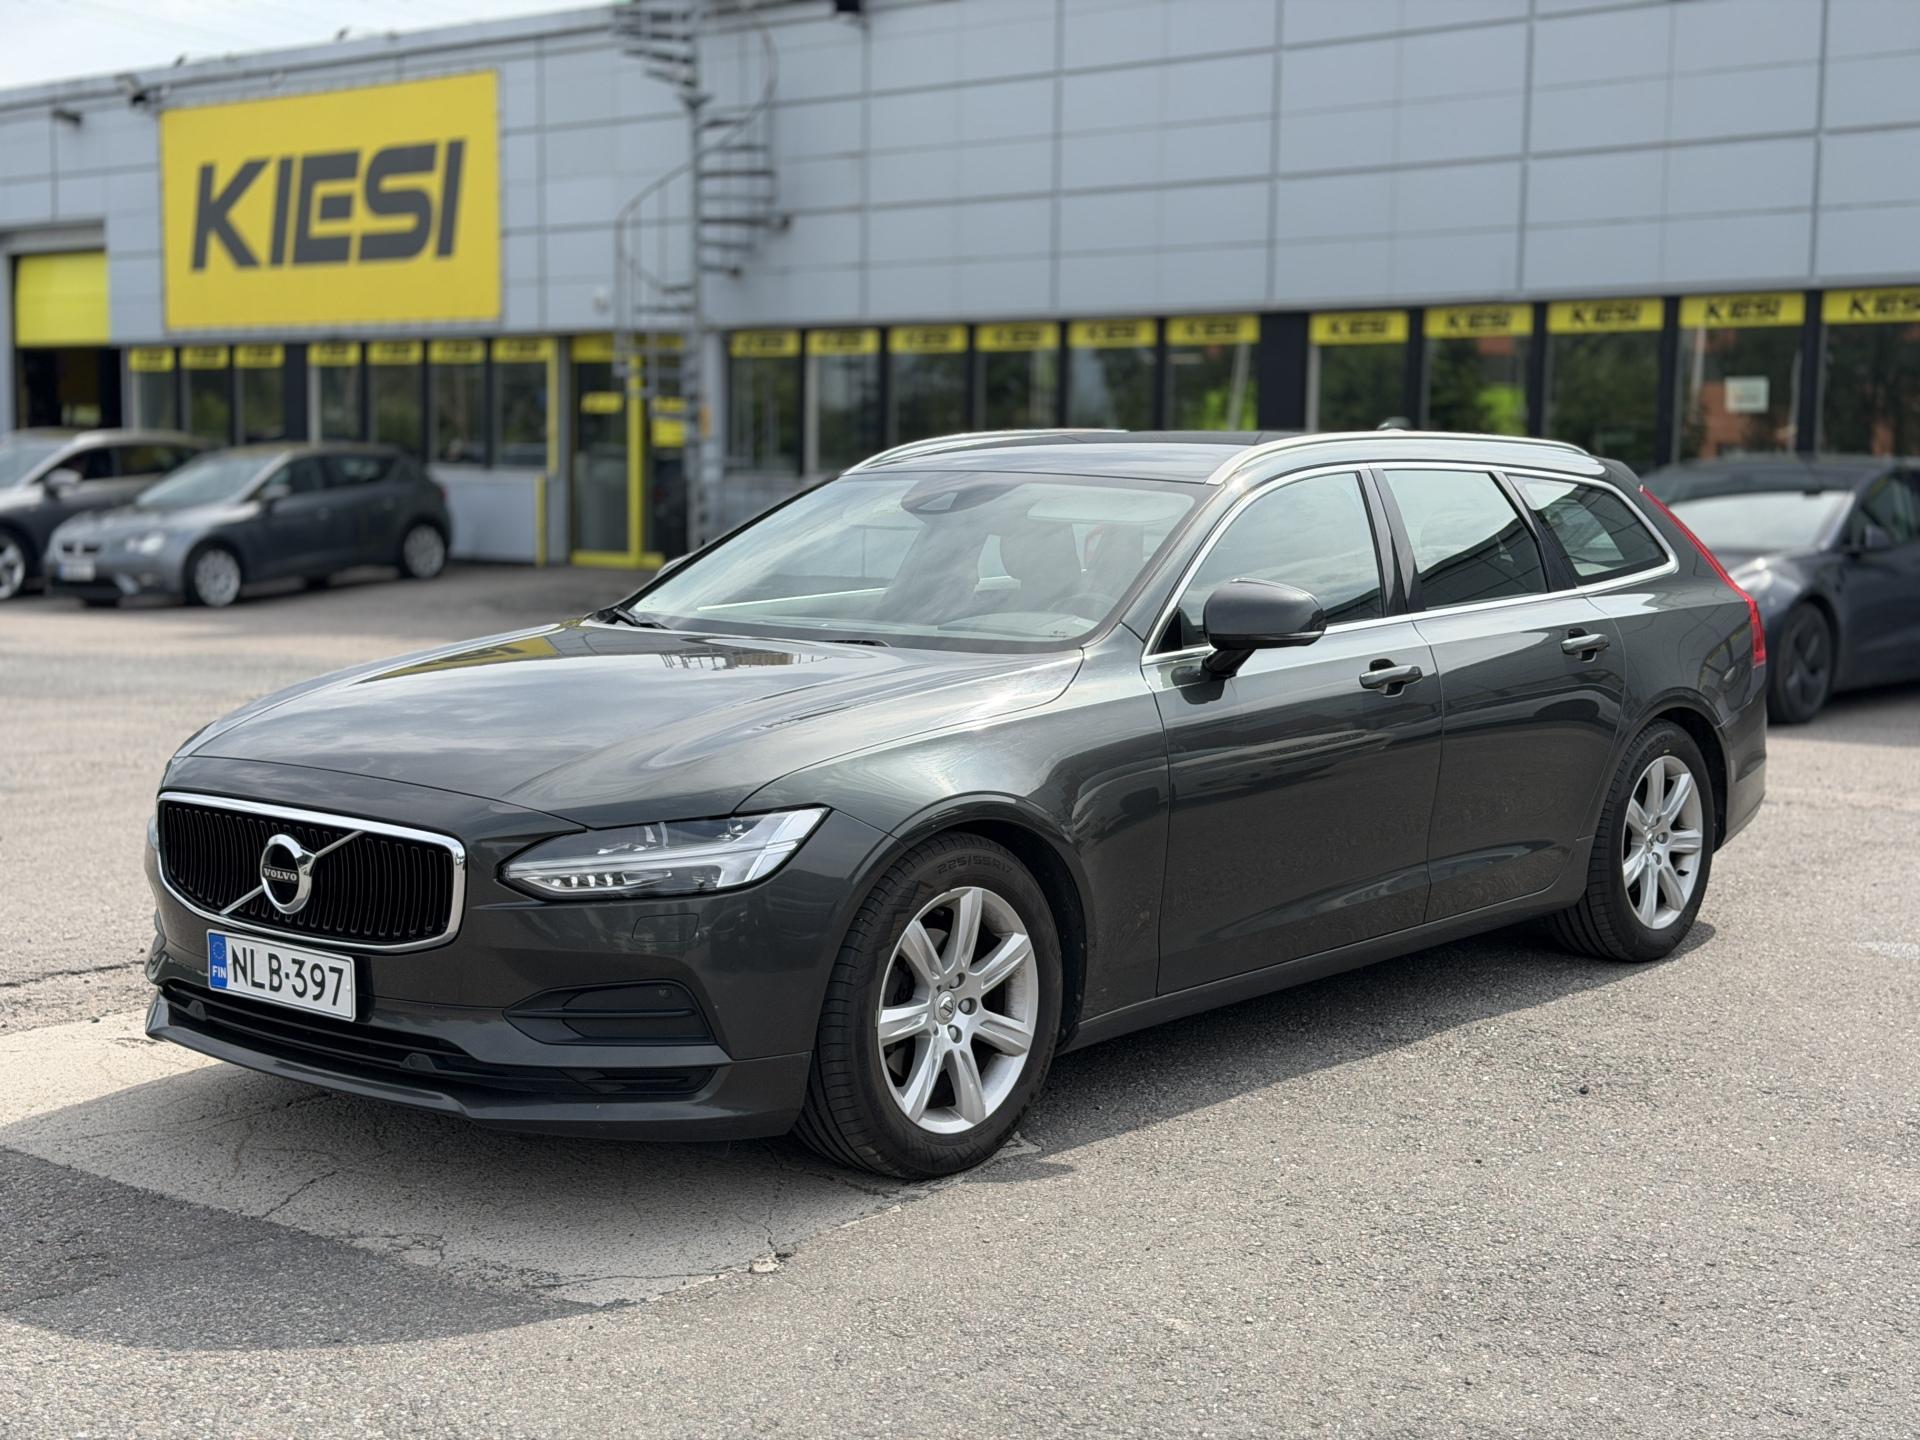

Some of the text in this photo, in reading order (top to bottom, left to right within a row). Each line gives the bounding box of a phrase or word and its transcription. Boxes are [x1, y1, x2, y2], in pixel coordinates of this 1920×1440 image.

[191, 137, 467, 272] KIESI
[937, 855, 1013, 874] 225/55R17
[264, 869, 298, 882] VOLVO
[213, 966, 227, 979] FIN
[231, 946, 344, 1006] NLB-397
